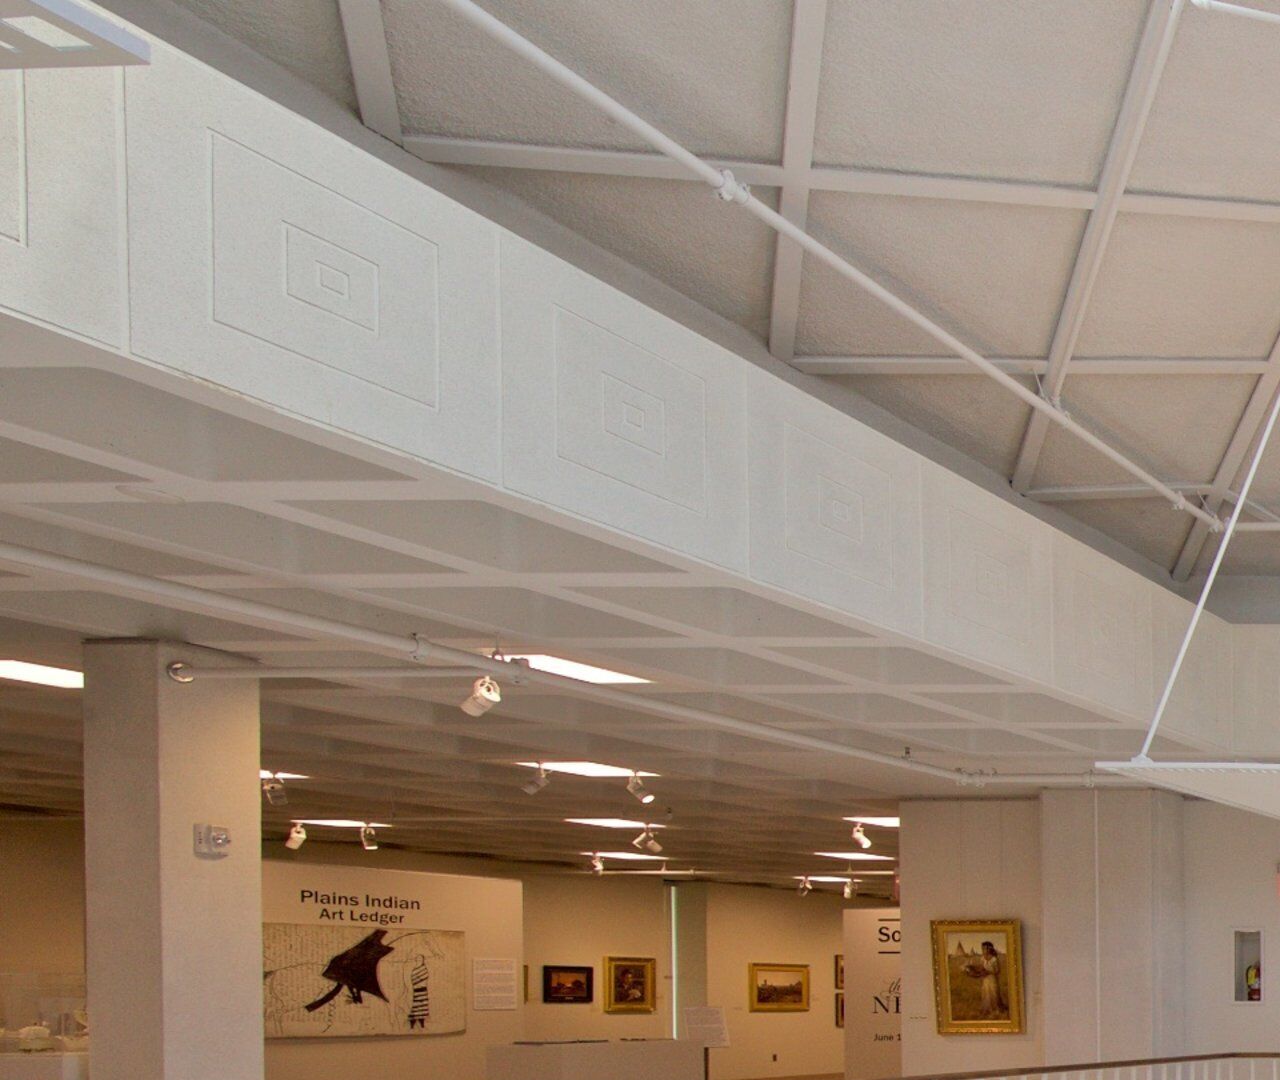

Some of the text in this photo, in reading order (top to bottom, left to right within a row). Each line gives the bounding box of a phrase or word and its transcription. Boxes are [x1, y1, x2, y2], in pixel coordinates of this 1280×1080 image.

[300, 889, 421, 911] Plains Indian
[319, 908, 405, 925] Art Ledger
